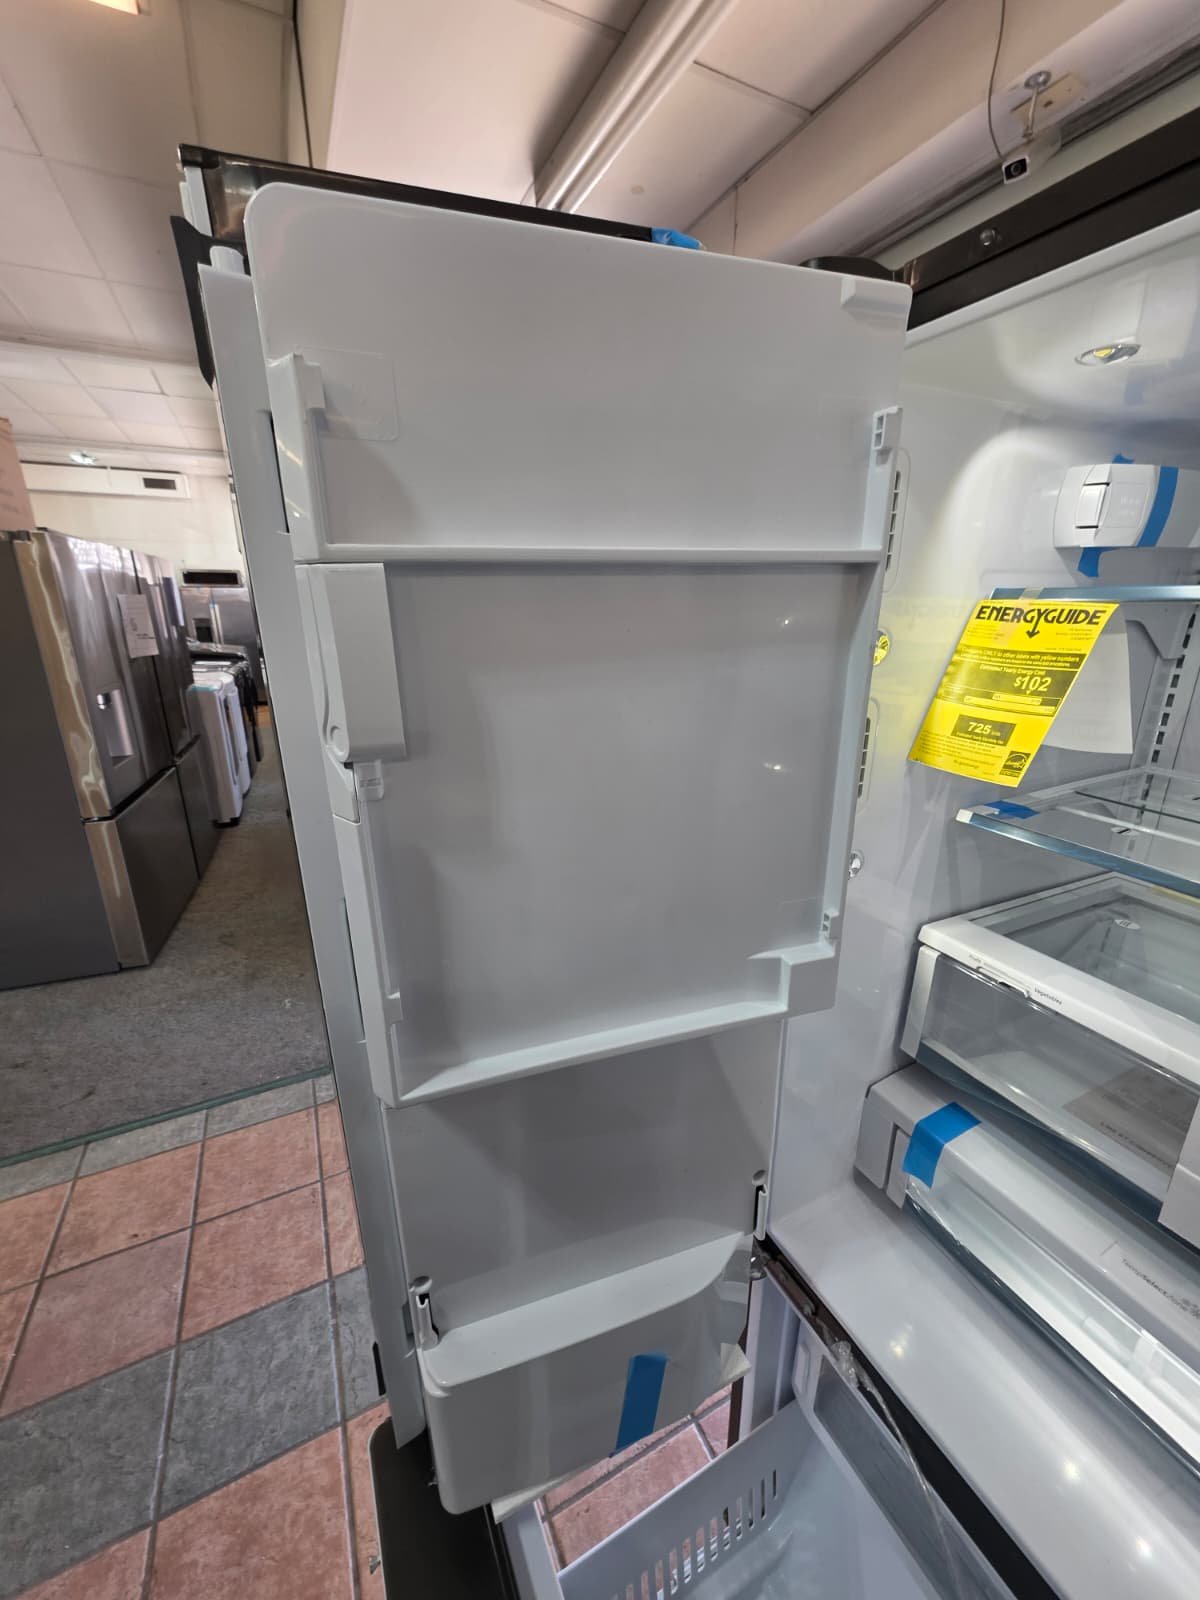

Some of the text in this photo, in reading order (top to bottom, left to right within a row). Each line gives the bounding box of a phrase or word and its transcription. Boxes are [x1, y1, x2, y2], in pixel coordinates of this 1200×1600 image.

[975, 605, 1107, 626] ENERGYGUIDE
[1013, 675, 1052, 692] $102
[967, 722, 992, 735] 725
